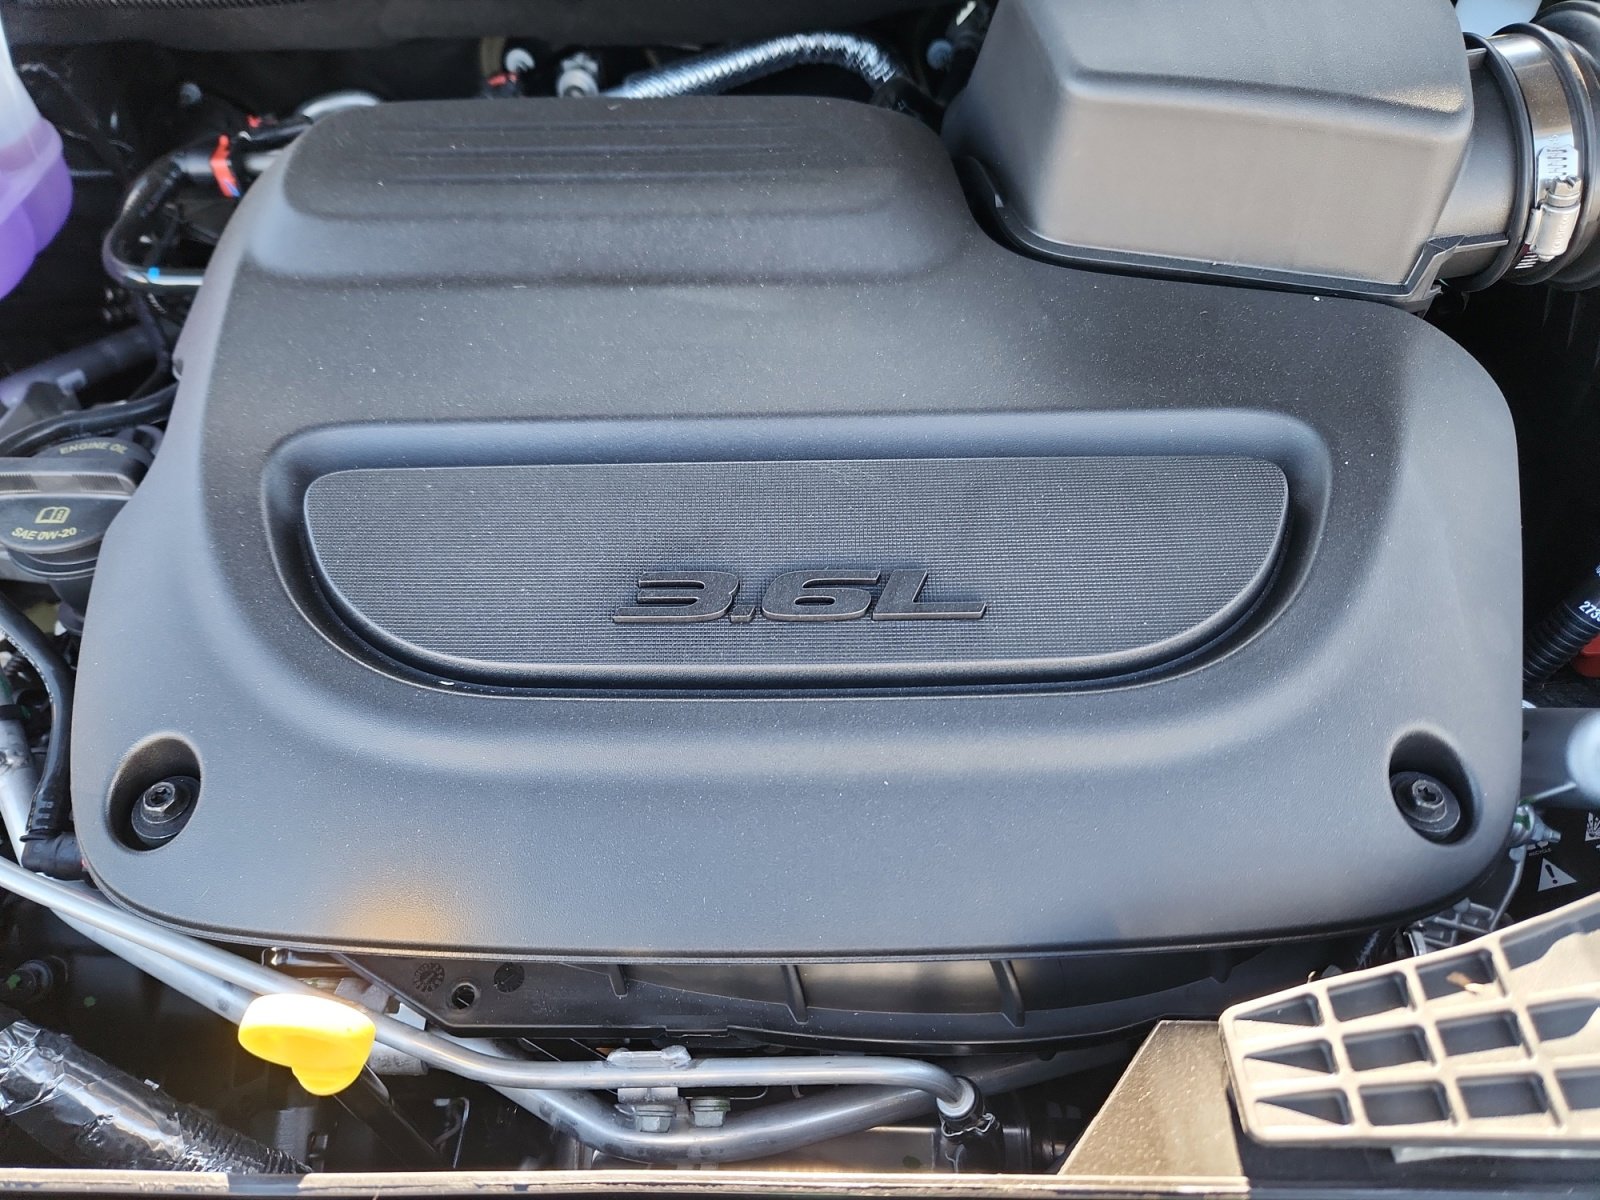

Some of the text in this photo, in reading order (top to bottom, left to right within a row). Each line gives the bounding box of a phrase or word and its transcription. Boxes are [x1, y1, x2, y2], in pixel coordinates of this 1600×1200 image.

[60, 441, 129, 455] ENGINE OIL
[11, 526, 77, 541] SAE 0W-20
[613, 569, 987, 622] 3.6L
